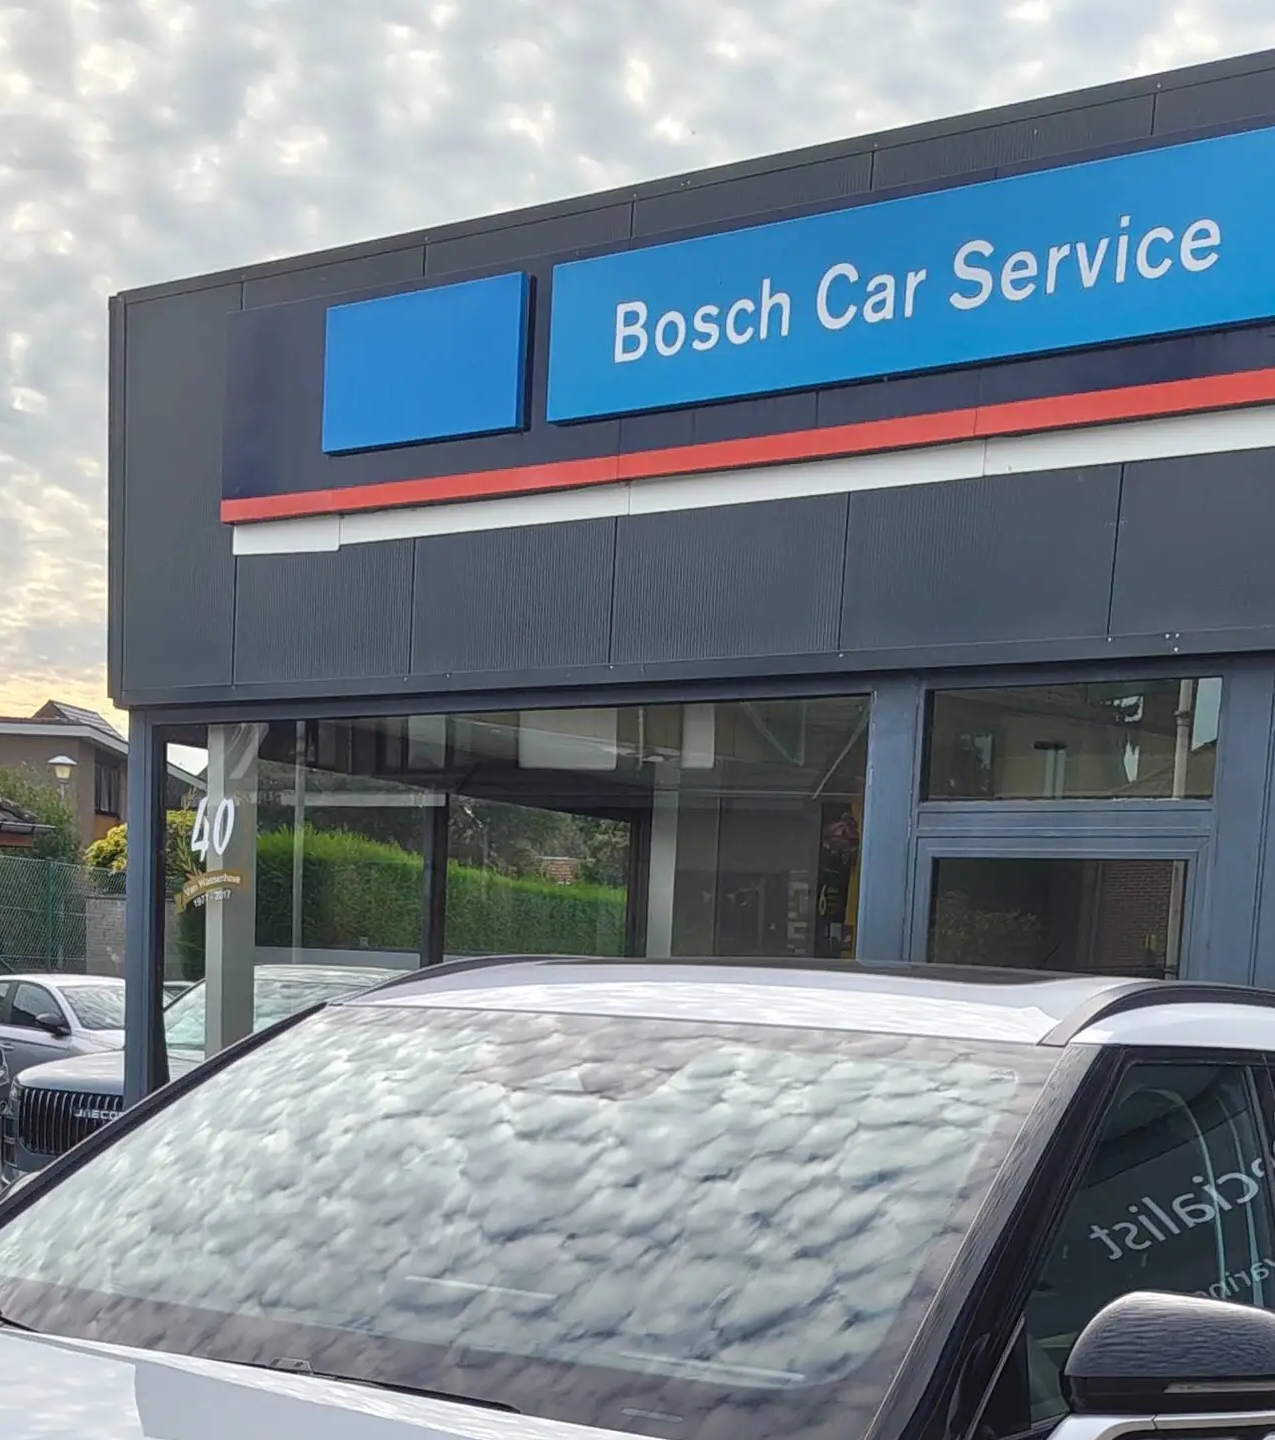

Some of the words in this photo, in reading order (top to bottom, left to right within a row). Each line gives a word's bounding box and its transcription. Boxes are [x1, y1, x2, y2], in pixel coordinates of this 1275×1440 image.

[614, 278, 791, 364] Bosch
[816, 262, 926, 330] Car
[950, 216, 1221, 311] Service
[191, 797, 235, 862] 40
